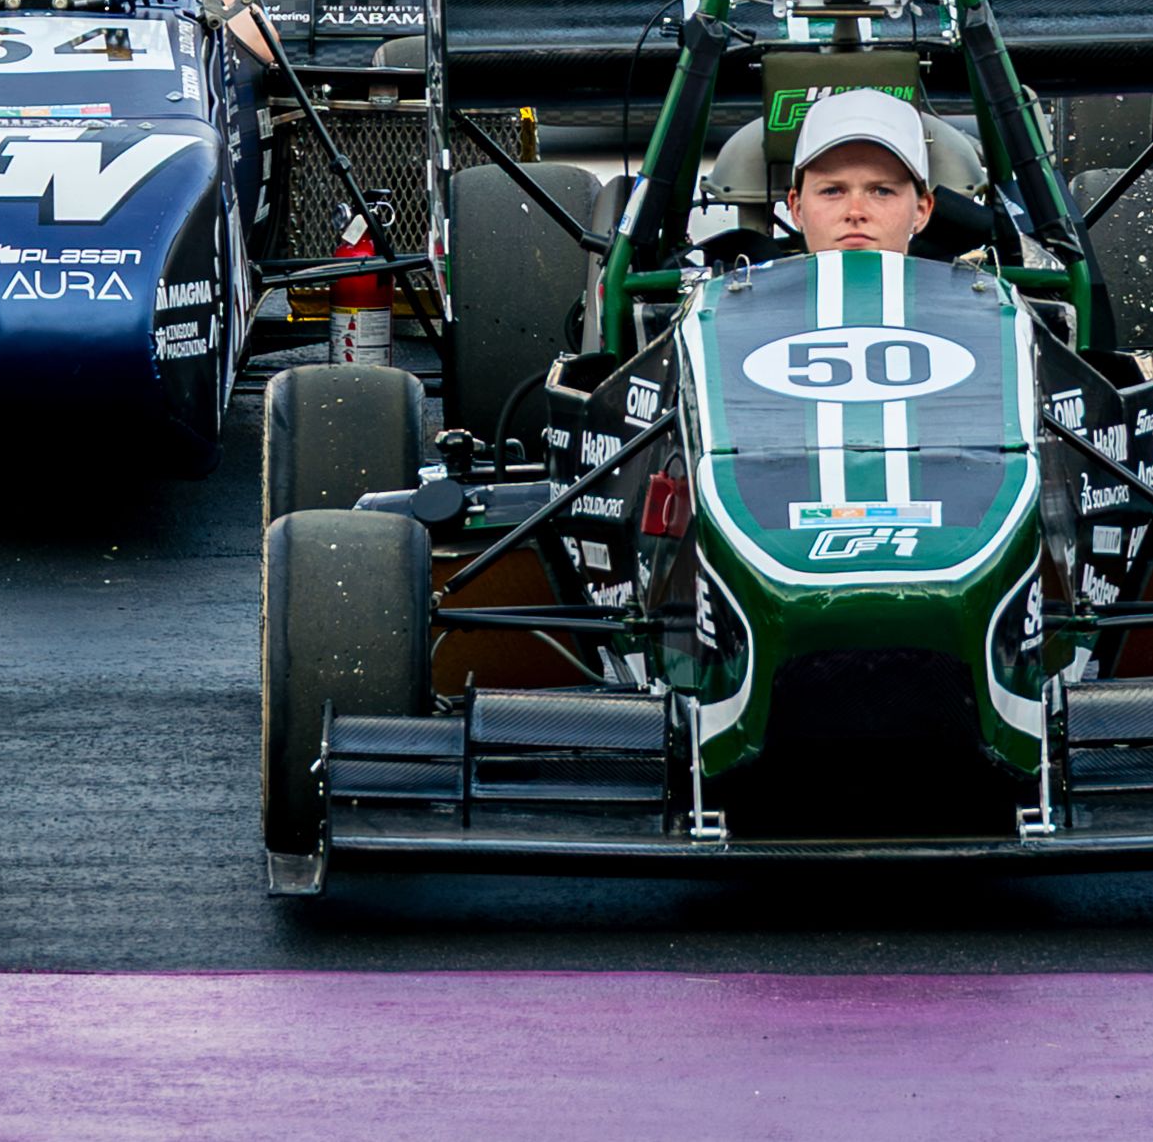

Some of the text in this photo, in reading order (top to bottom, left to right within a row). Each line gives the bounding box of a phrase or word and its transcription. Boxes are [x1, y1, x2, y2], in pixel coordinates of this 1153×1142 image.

[1, 270, 134, 301] AURA
[168, 280, 212, 308] MAGNA
[166, 320, 198, 341] KINGDOM
[166, 337, 208, 360] MACHINING
[788, 340, 932, 387] 50
[626, 385, 659, 420] OMP
[1054, 397, 1085, 431] OMP
